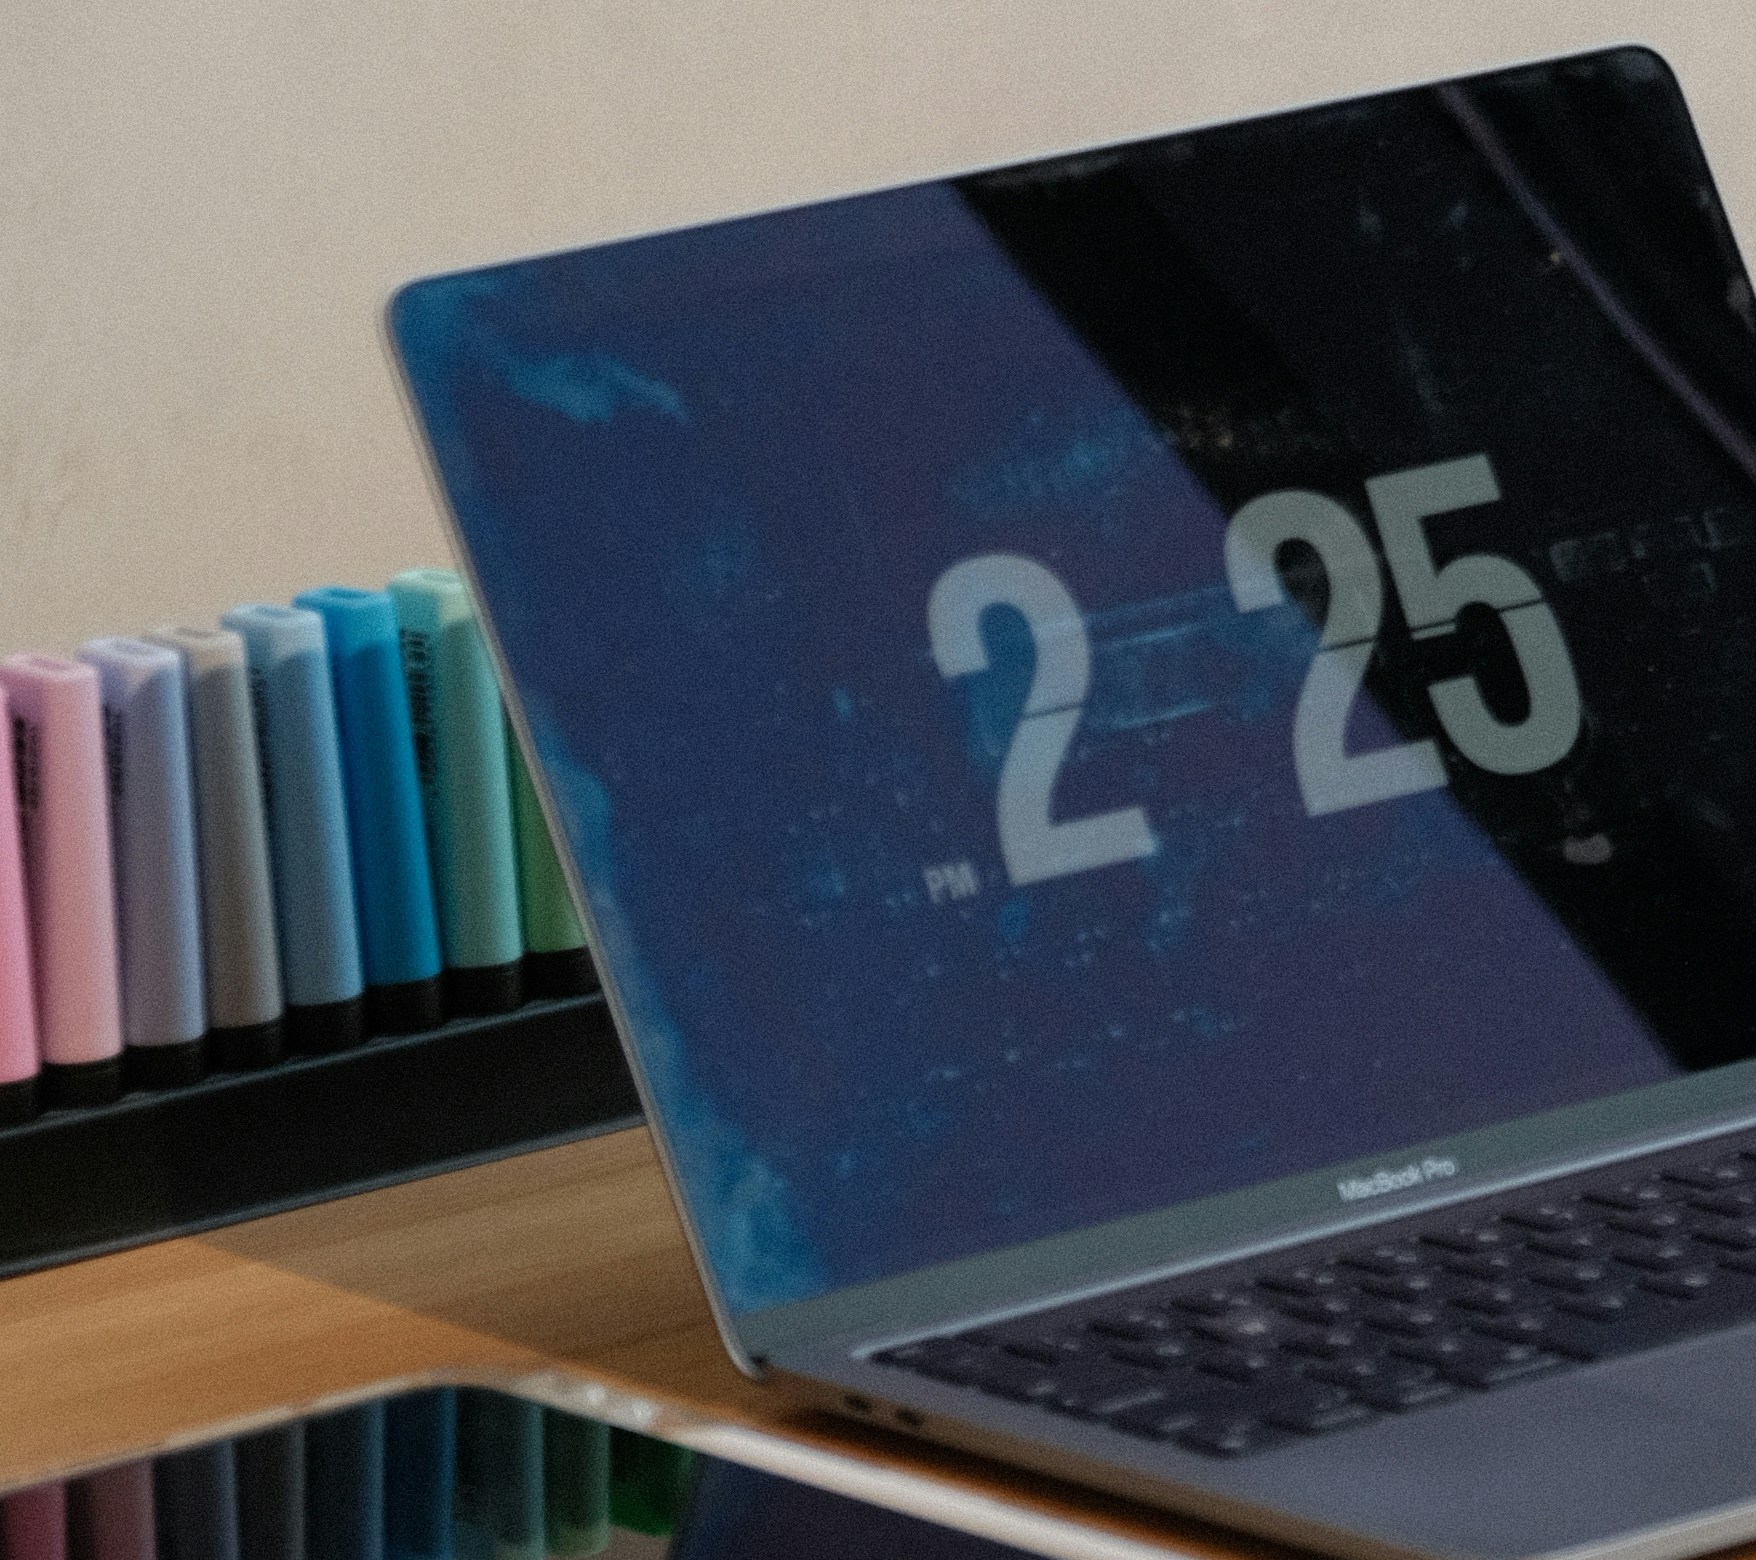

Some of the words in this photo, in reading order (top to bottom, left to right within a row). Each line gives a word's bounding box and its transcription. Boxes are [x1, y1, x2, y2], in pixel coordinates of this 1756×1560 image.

[927, 553, 1160, 888] 2
[1223, 453, 1583, 817] 25
[922, 860, 980, 905] PM
[1336, 1165, 1424, 1203] MacBook
[1422, 1158, 1456, 1181] Pro
